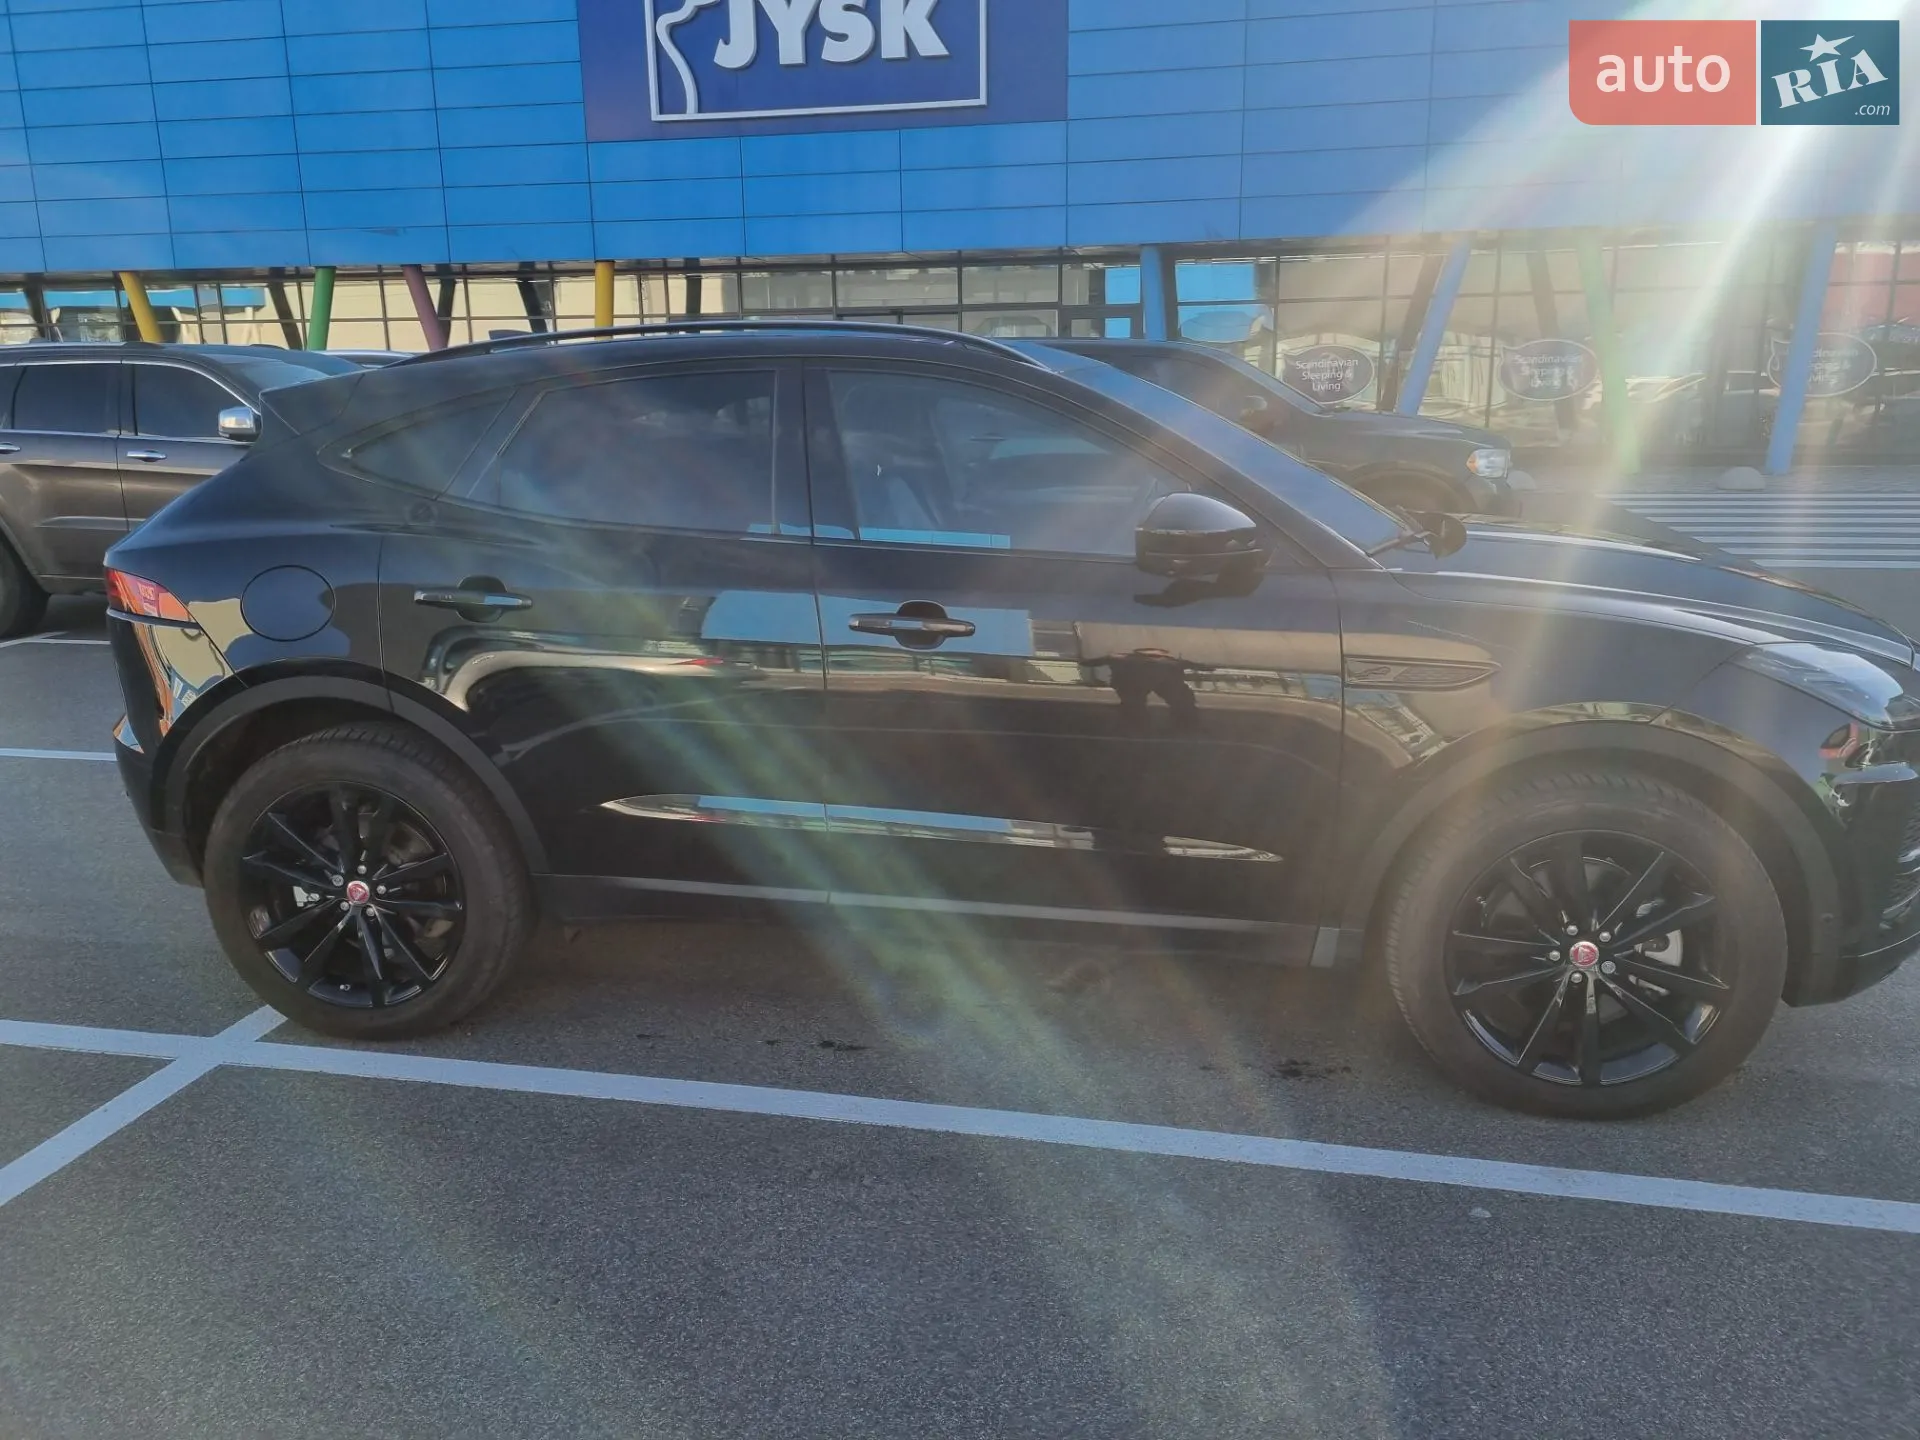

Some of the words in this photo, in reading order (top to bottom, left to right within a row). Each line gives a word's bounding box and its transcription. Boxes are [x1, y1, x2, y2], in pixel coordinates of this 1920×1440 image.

[713, 0, 950, 69] JYSK
[1295, 359, 1359, 370] Scandinavian
[1301, 371, 1344, 382] Sleeping
[1312, 381, 1342, 392] Living
